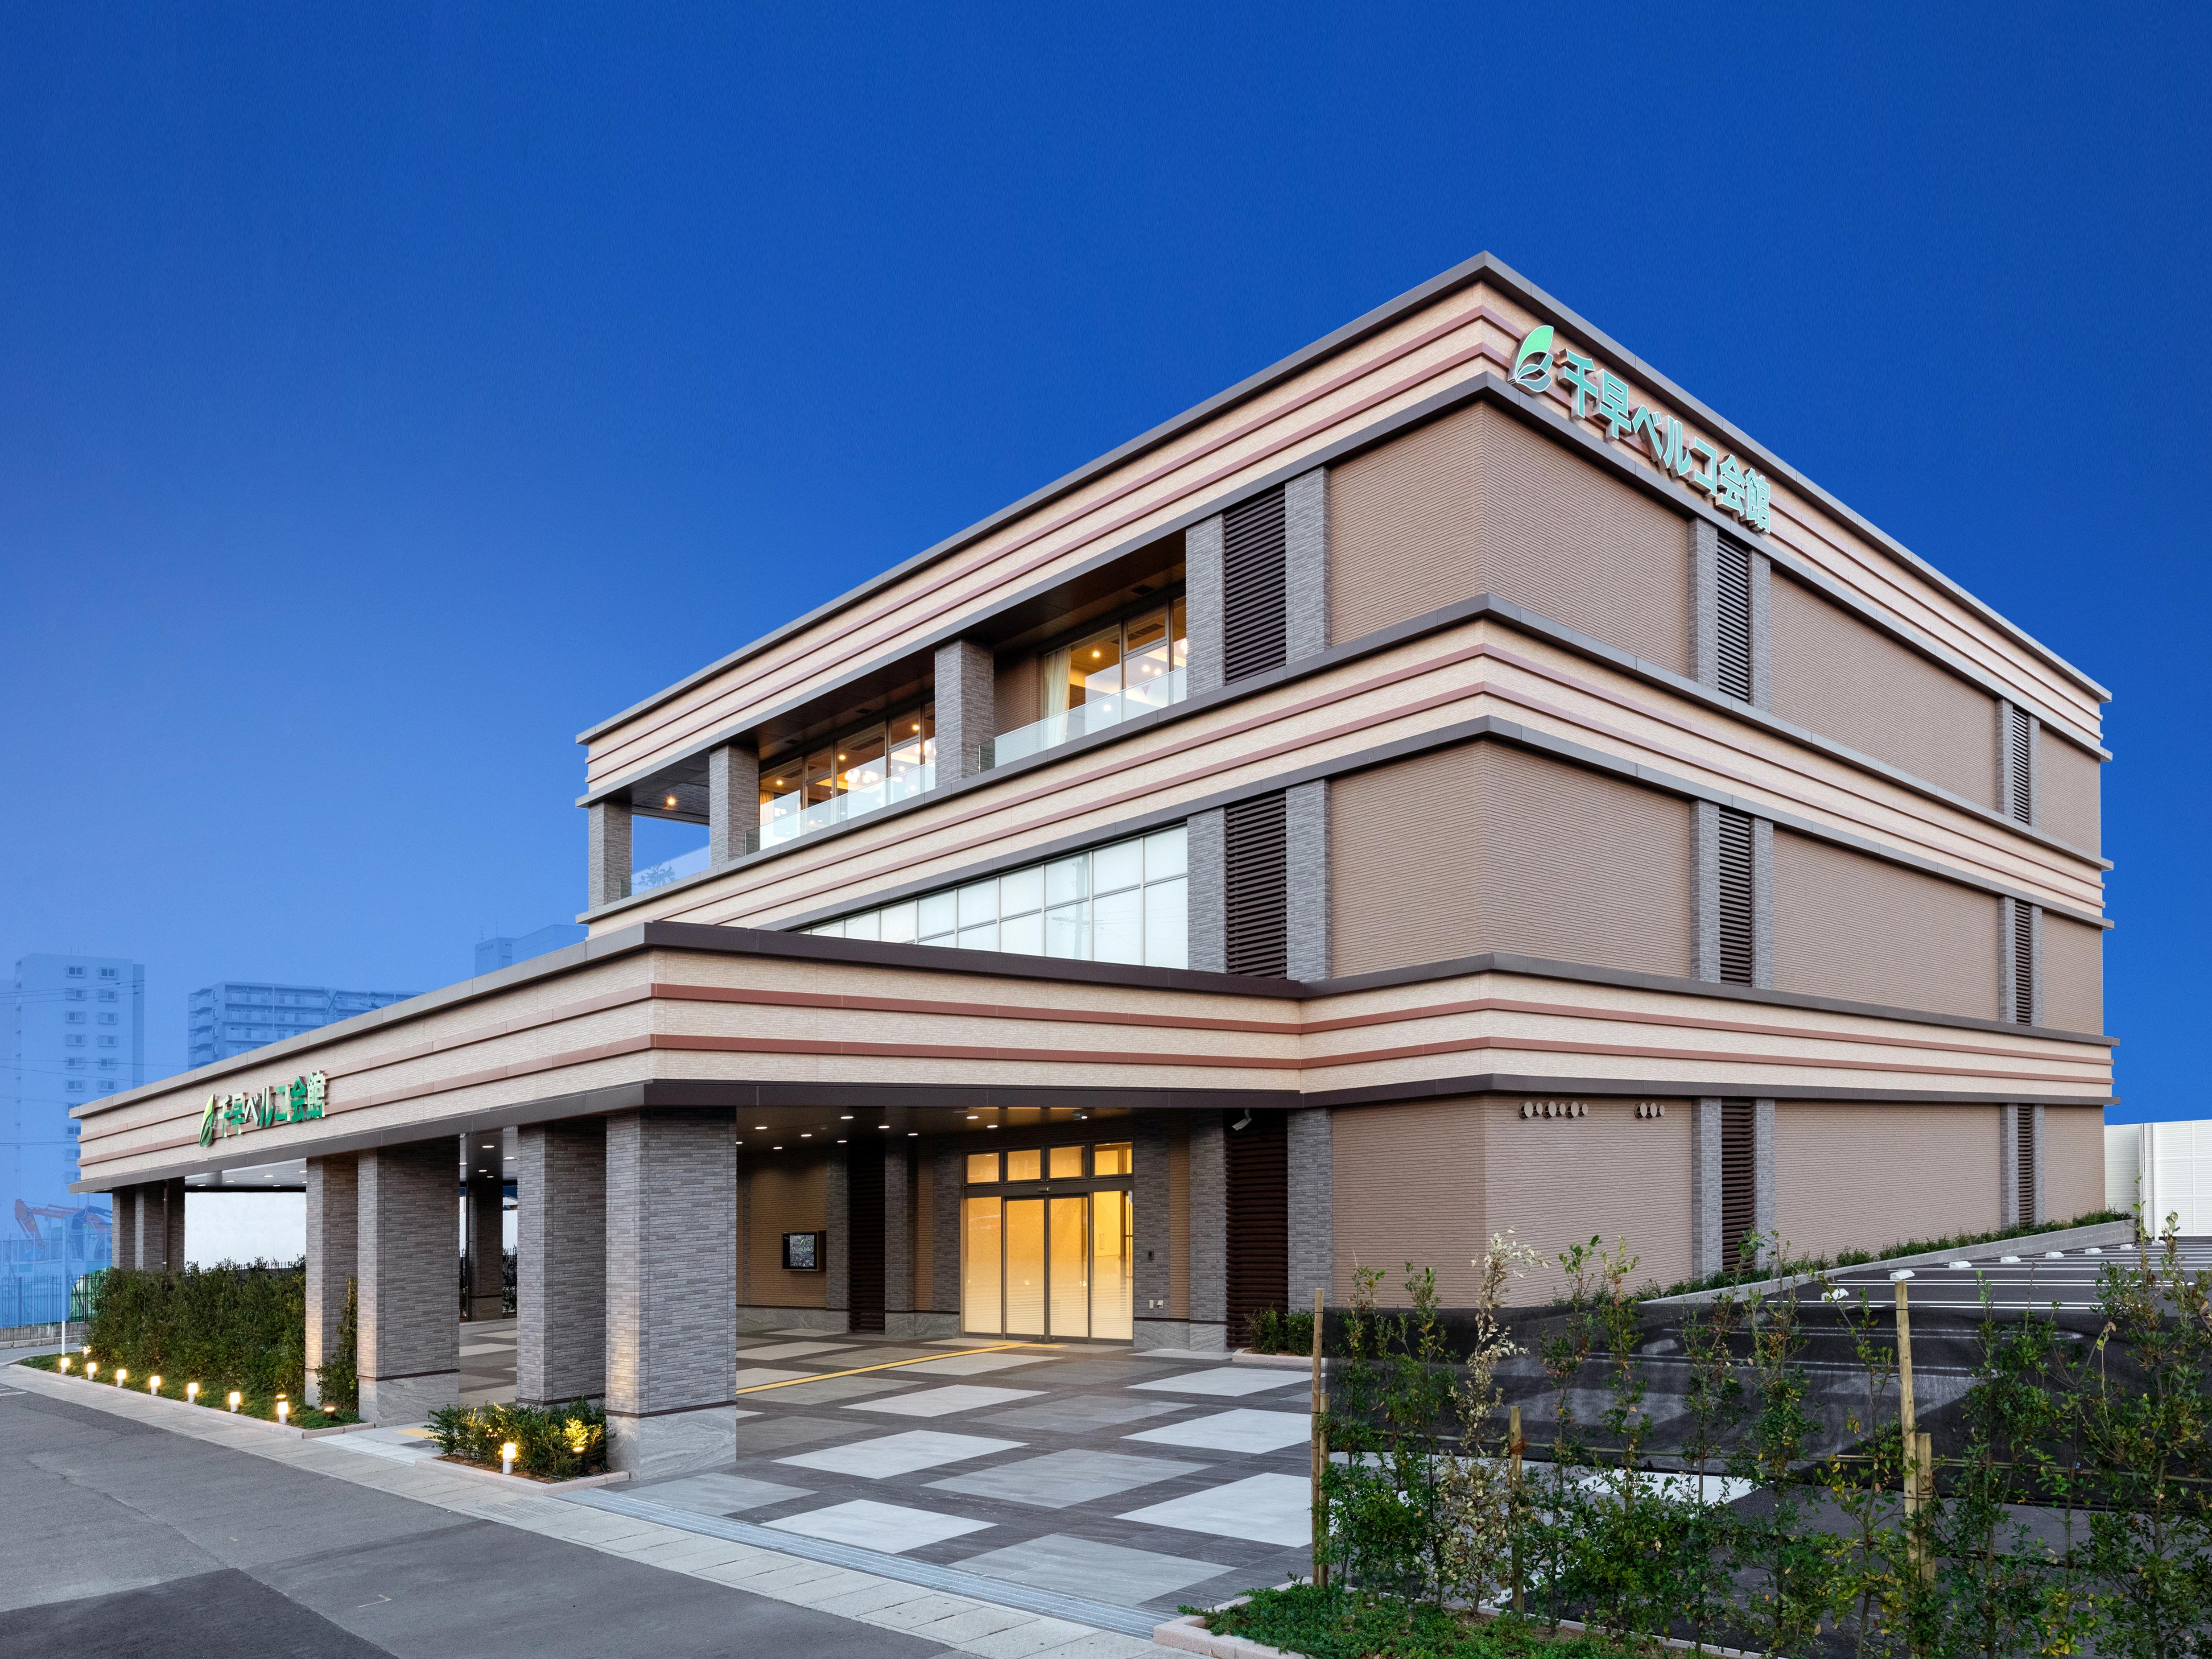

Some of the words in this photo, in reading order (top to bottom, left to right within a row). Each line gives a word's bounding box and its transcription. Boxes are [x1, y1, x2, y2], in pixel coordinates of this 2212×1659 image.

[1559, 348, 1770, 533] 千早ベルコ会館
[217, 1070, 326, 1138] 千早ベルコ会館
